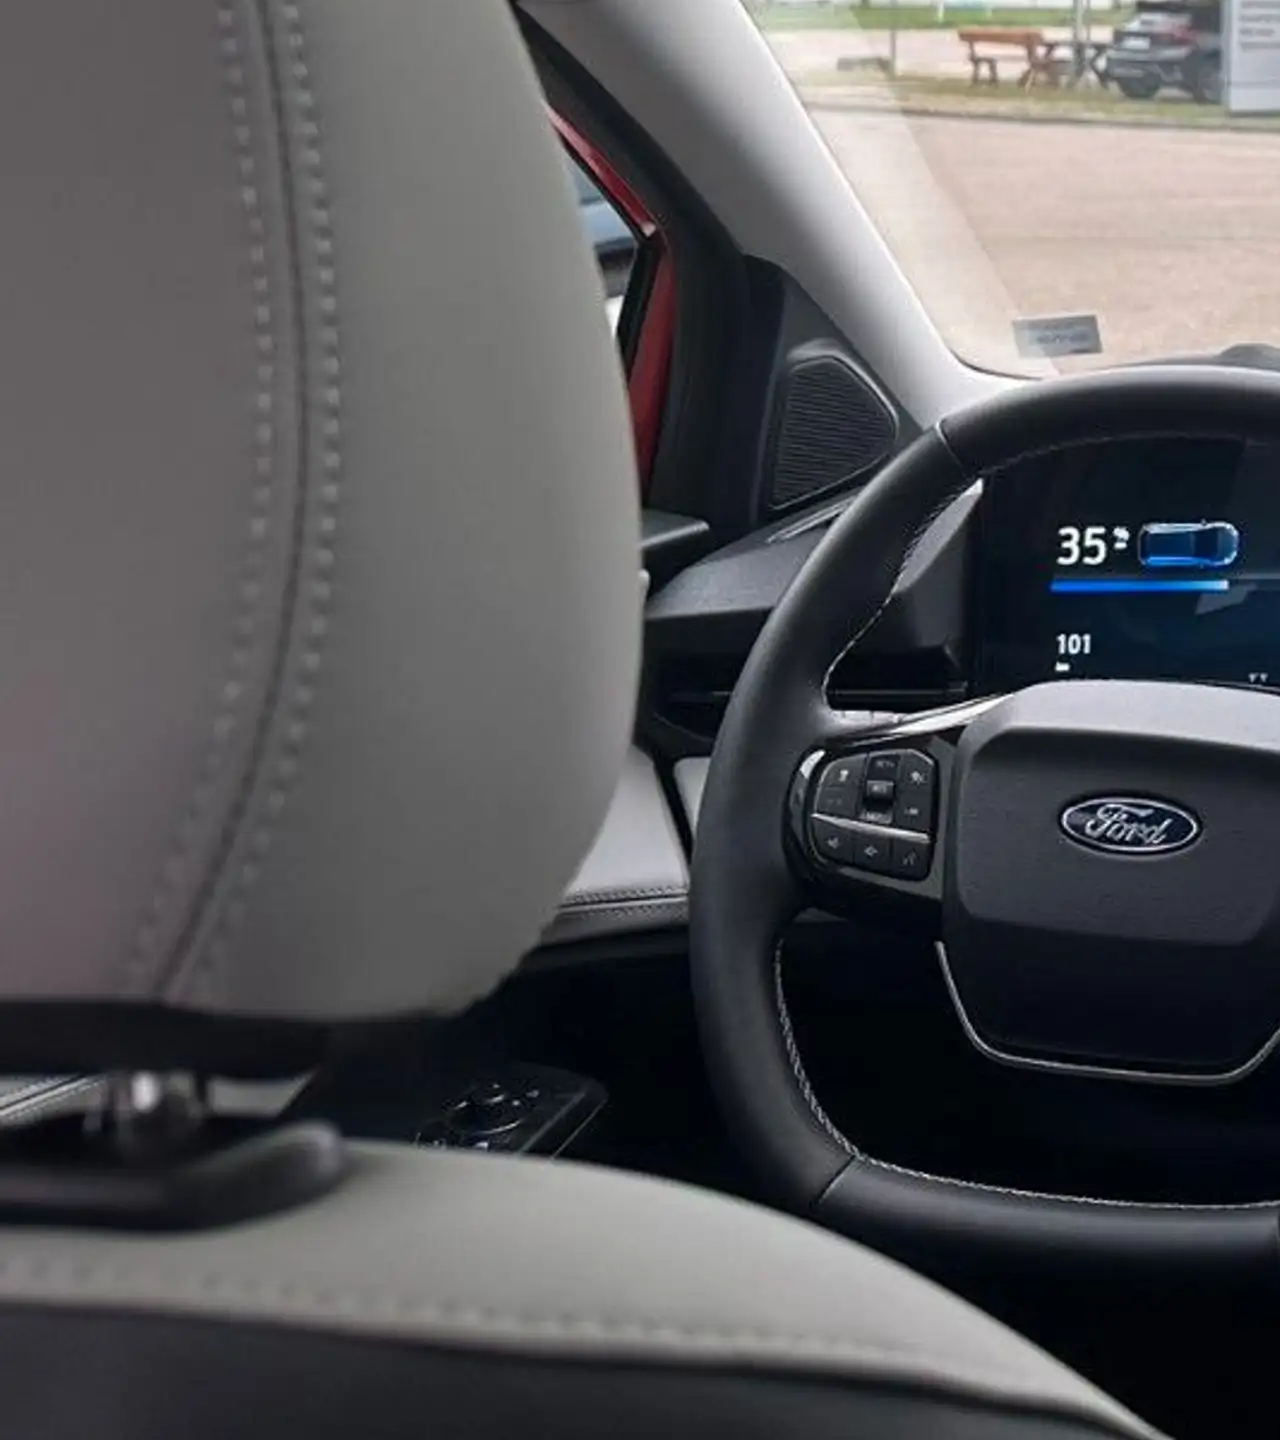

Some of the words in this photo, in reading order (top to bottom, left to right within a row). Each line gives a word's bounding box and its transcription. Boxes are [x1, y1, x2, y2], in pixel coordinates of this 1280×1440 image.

[1056, 526, 1106, 565] 35
[1056, 633, 1091, 654] 101
[1085, 803, 1174, 844] Ford
